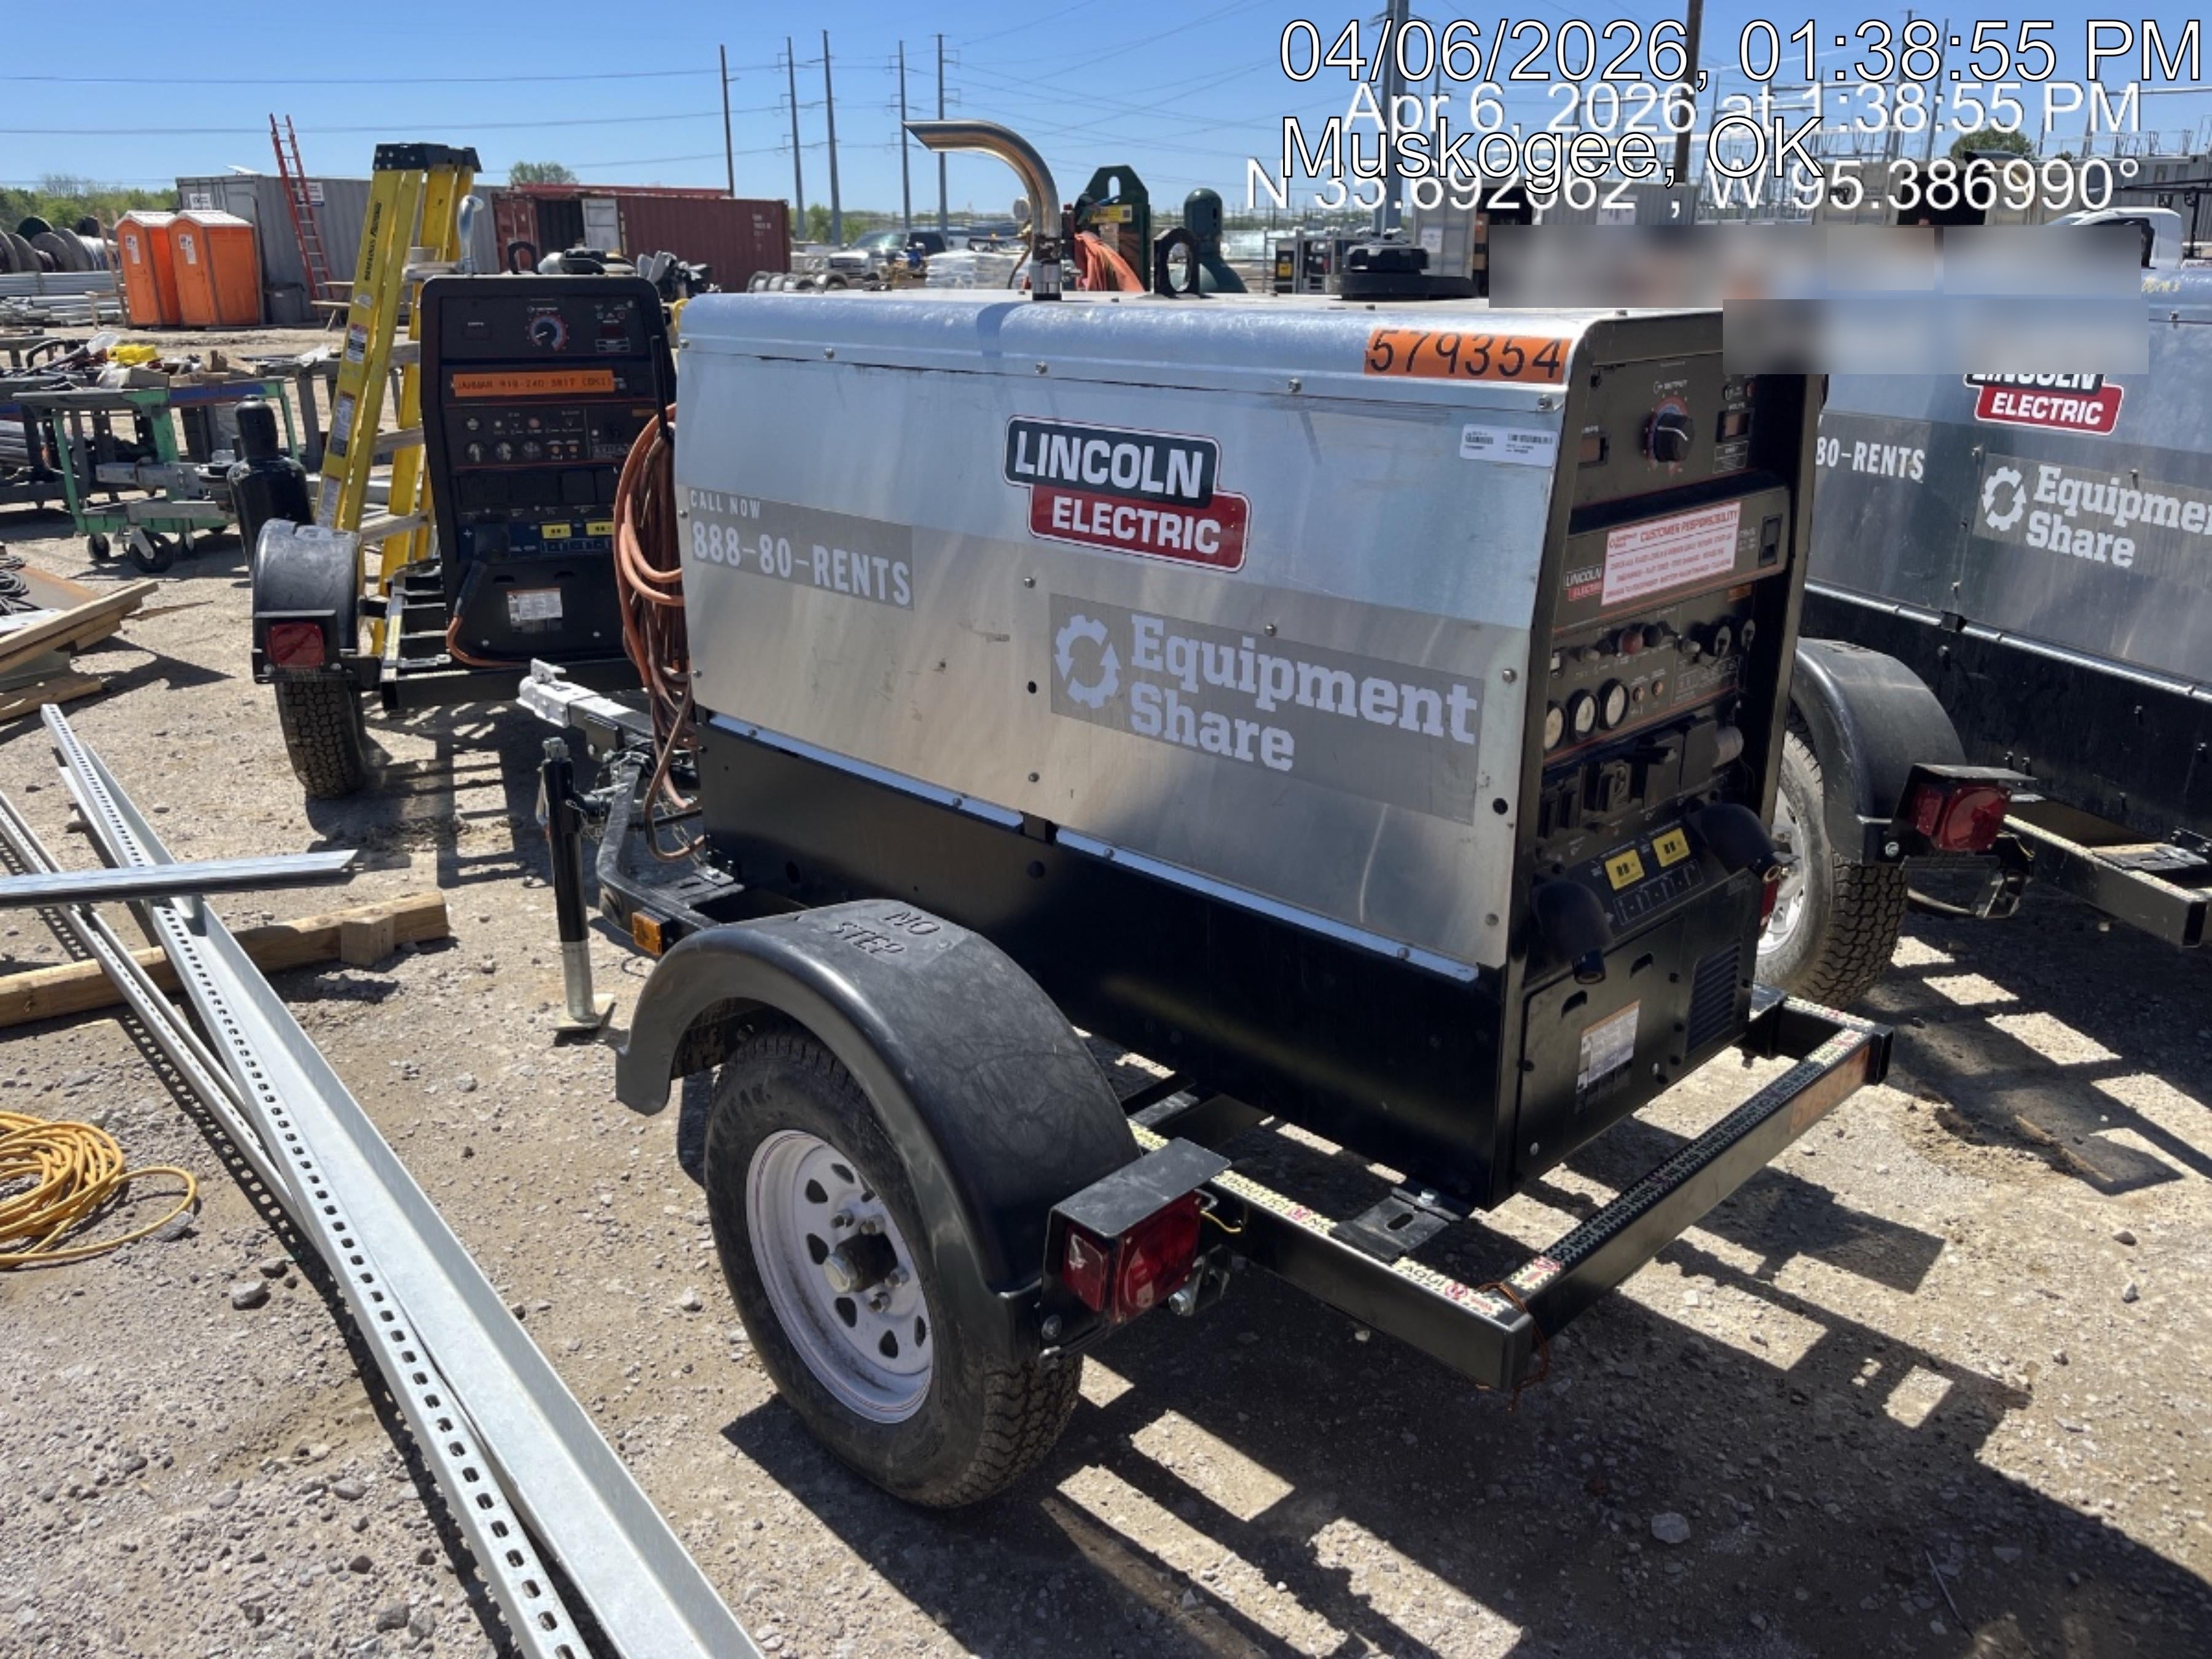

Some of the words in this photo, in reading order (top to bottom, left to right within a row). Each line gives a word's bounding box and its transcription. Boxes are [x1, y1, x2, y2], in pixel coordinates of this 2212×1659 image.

[1370, 329, 1563, 378] 579354
[1990, 392, 2104, 425] ELECTRIC
[1015, 430, 1204, 499] LINCOLN
[691, 490, 723, 512] CALL
[729, 496, 761, 519] NOW
[1051, 495, 1222, 554] ELECTRIC
[692, 520, 911, 606] 888-80-RENTS
[2026, 509, 2136, 569] Share
[1131, 614, 1478, 745] Equipment
[1131, 681, 1295, 772] Share
[831, 922, 904, 954] STEP
[884, 911, 941, 935] NO
